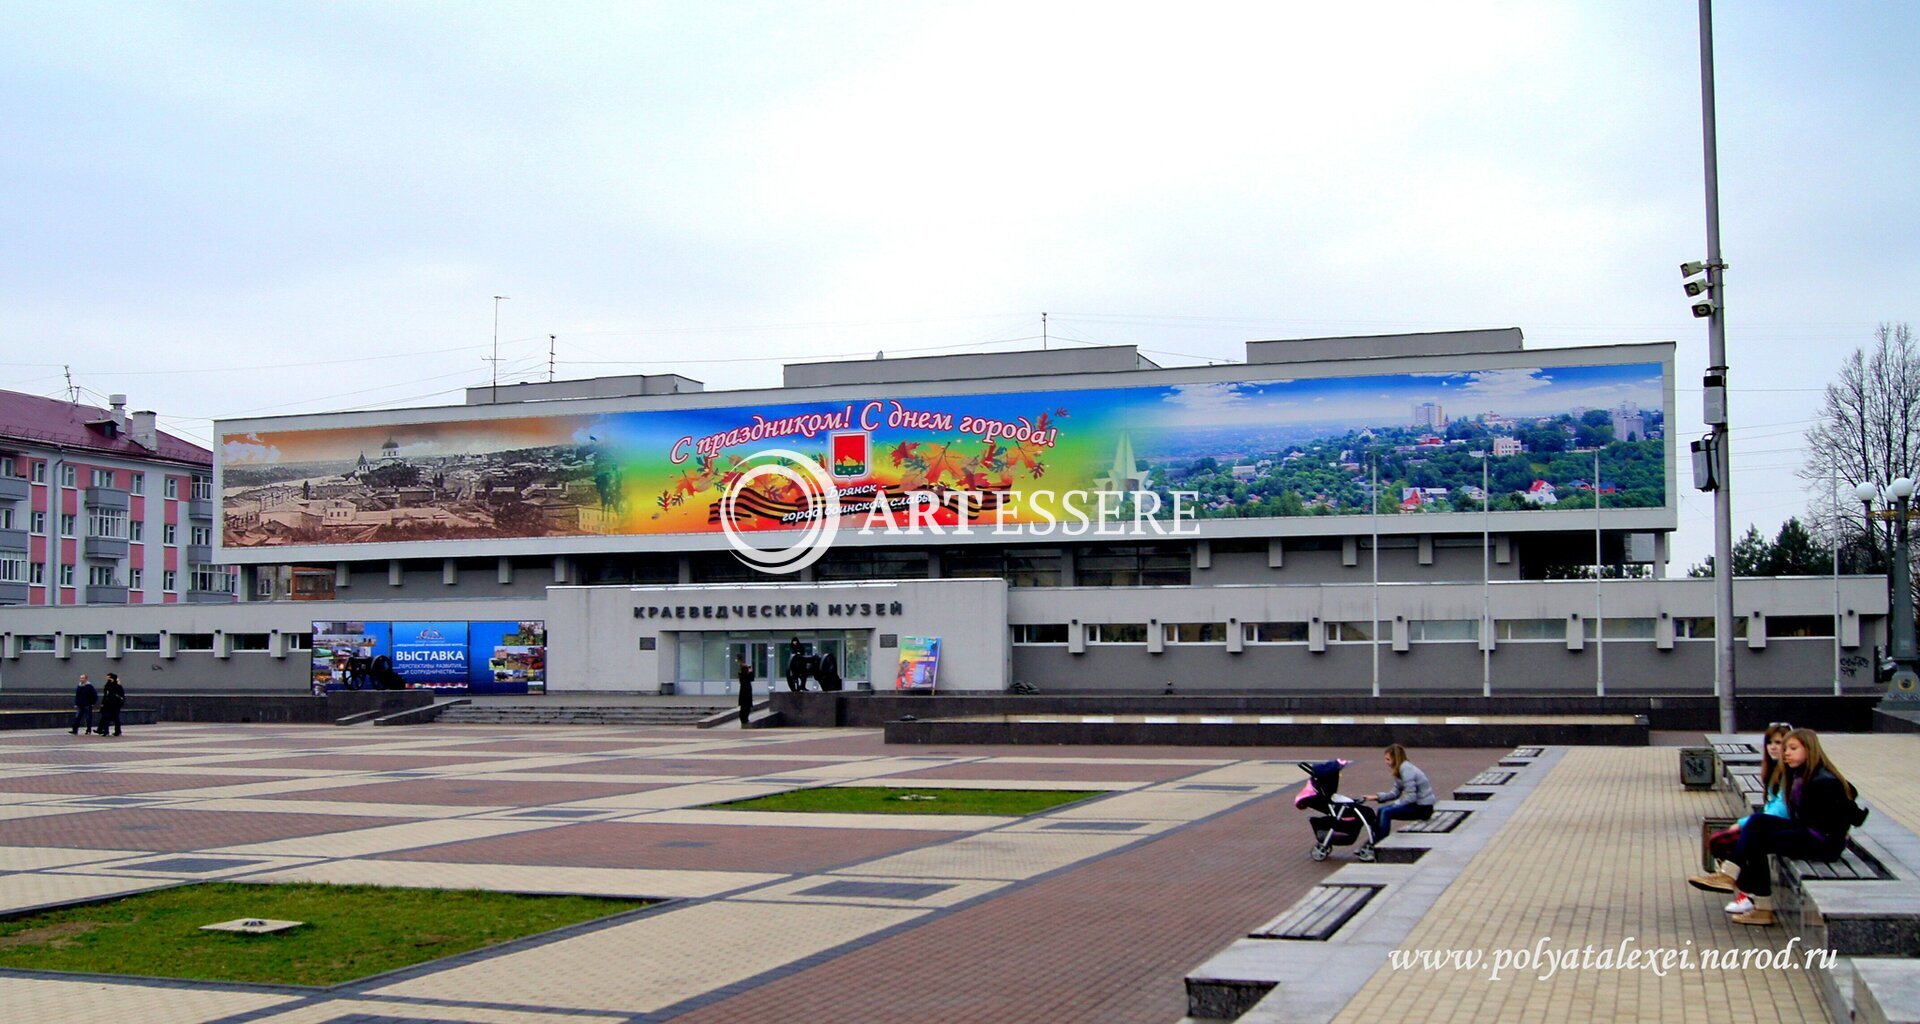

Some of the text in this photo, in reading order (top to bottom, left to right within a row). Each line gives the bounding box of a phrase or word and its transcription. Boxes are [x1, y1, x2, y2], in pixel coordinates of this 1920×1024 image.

[670, 400, 1057, 464] С праздником! С днем города!
[829, 484, 877, 499] Брянск
[782, 491, 933, 523] город воинской славы
[634, 600, 903, 619] КРАЕВЕДЧЕСКИЙ МУЗЕЙ
[396, 651, 465, 661] ВЫСТАВКА
